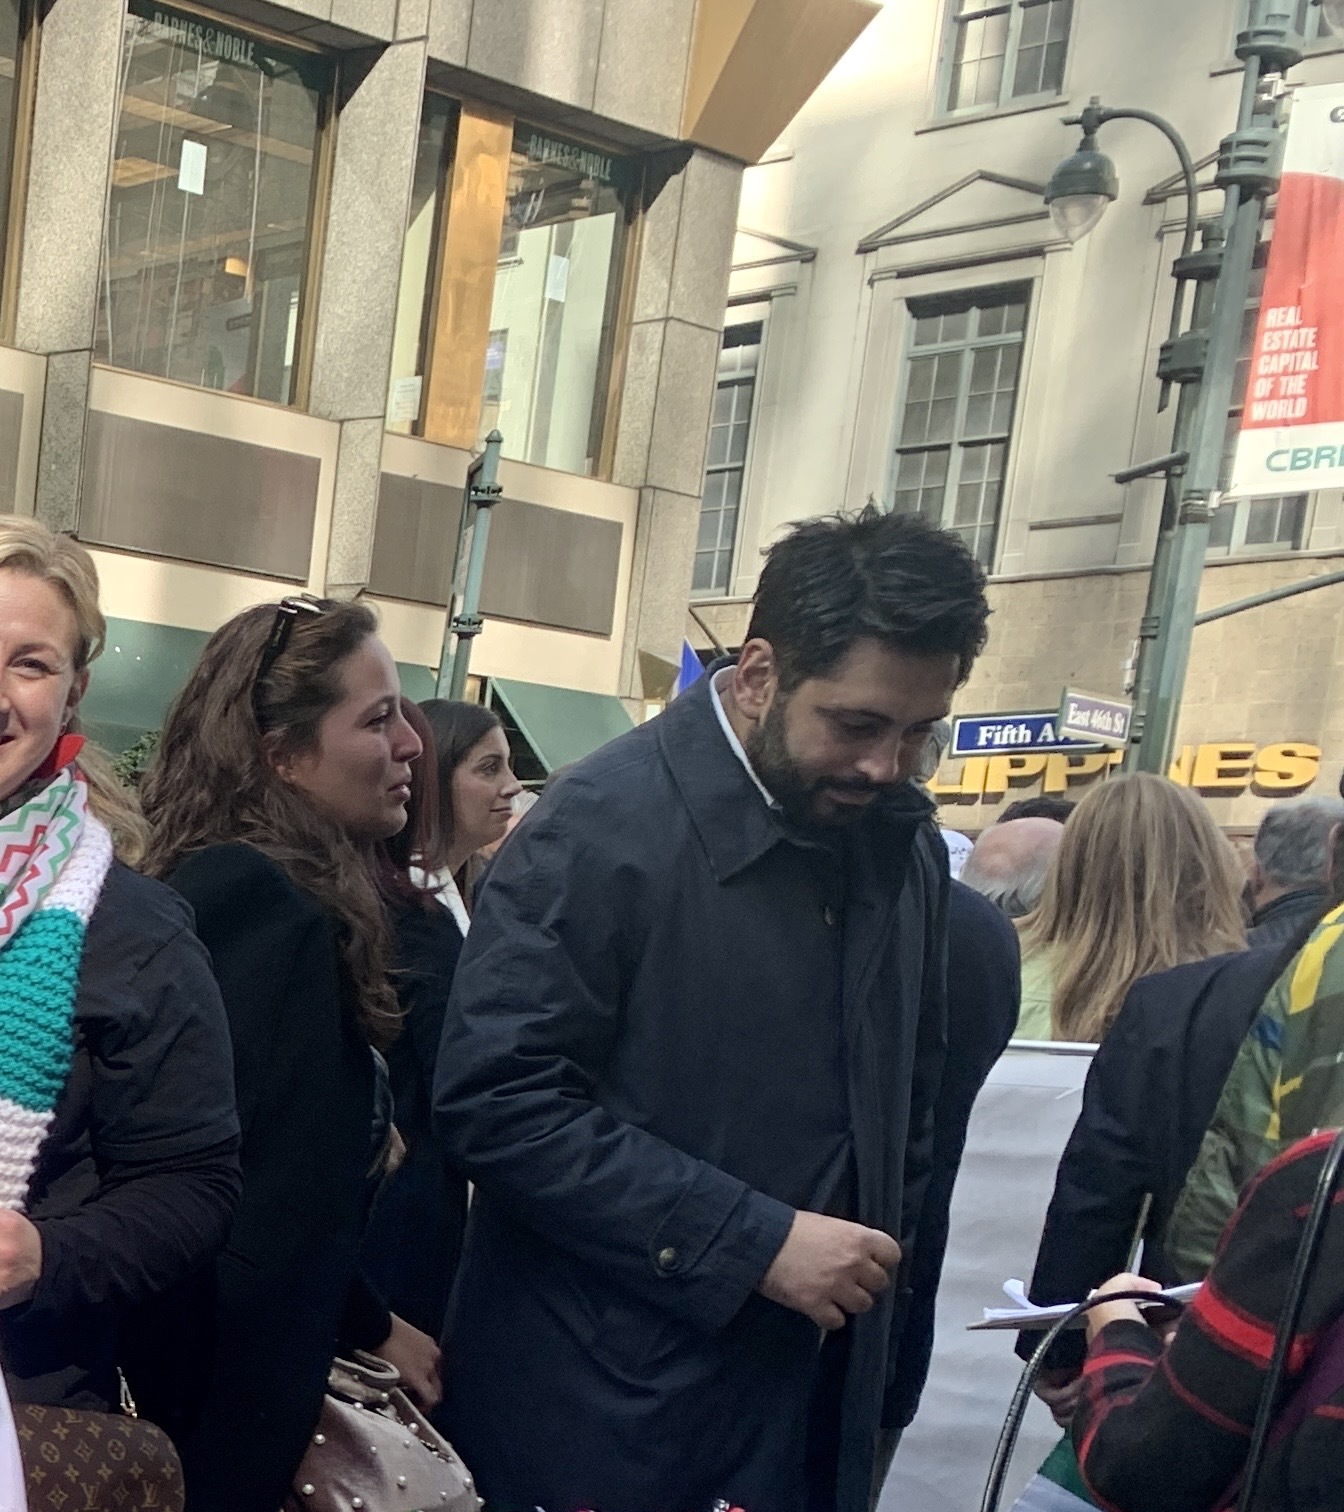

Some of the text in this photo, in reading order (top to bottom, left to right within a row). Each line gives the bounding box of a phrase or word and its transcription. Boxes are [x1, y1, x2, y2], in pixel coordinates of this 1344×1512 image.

[1265, 305, 1303, 328] REAL
[1262, 327, 1318, 352] ESTATE
[1258, 350, 1319, 375] CAPITAL
[1254, 374, 1308, 399] OF THE
[1251, 397, 1308, 421] WORLD
[1067, 703, 1125, 734] East 46th St
[977, 723, 1031, 746] Fifth
